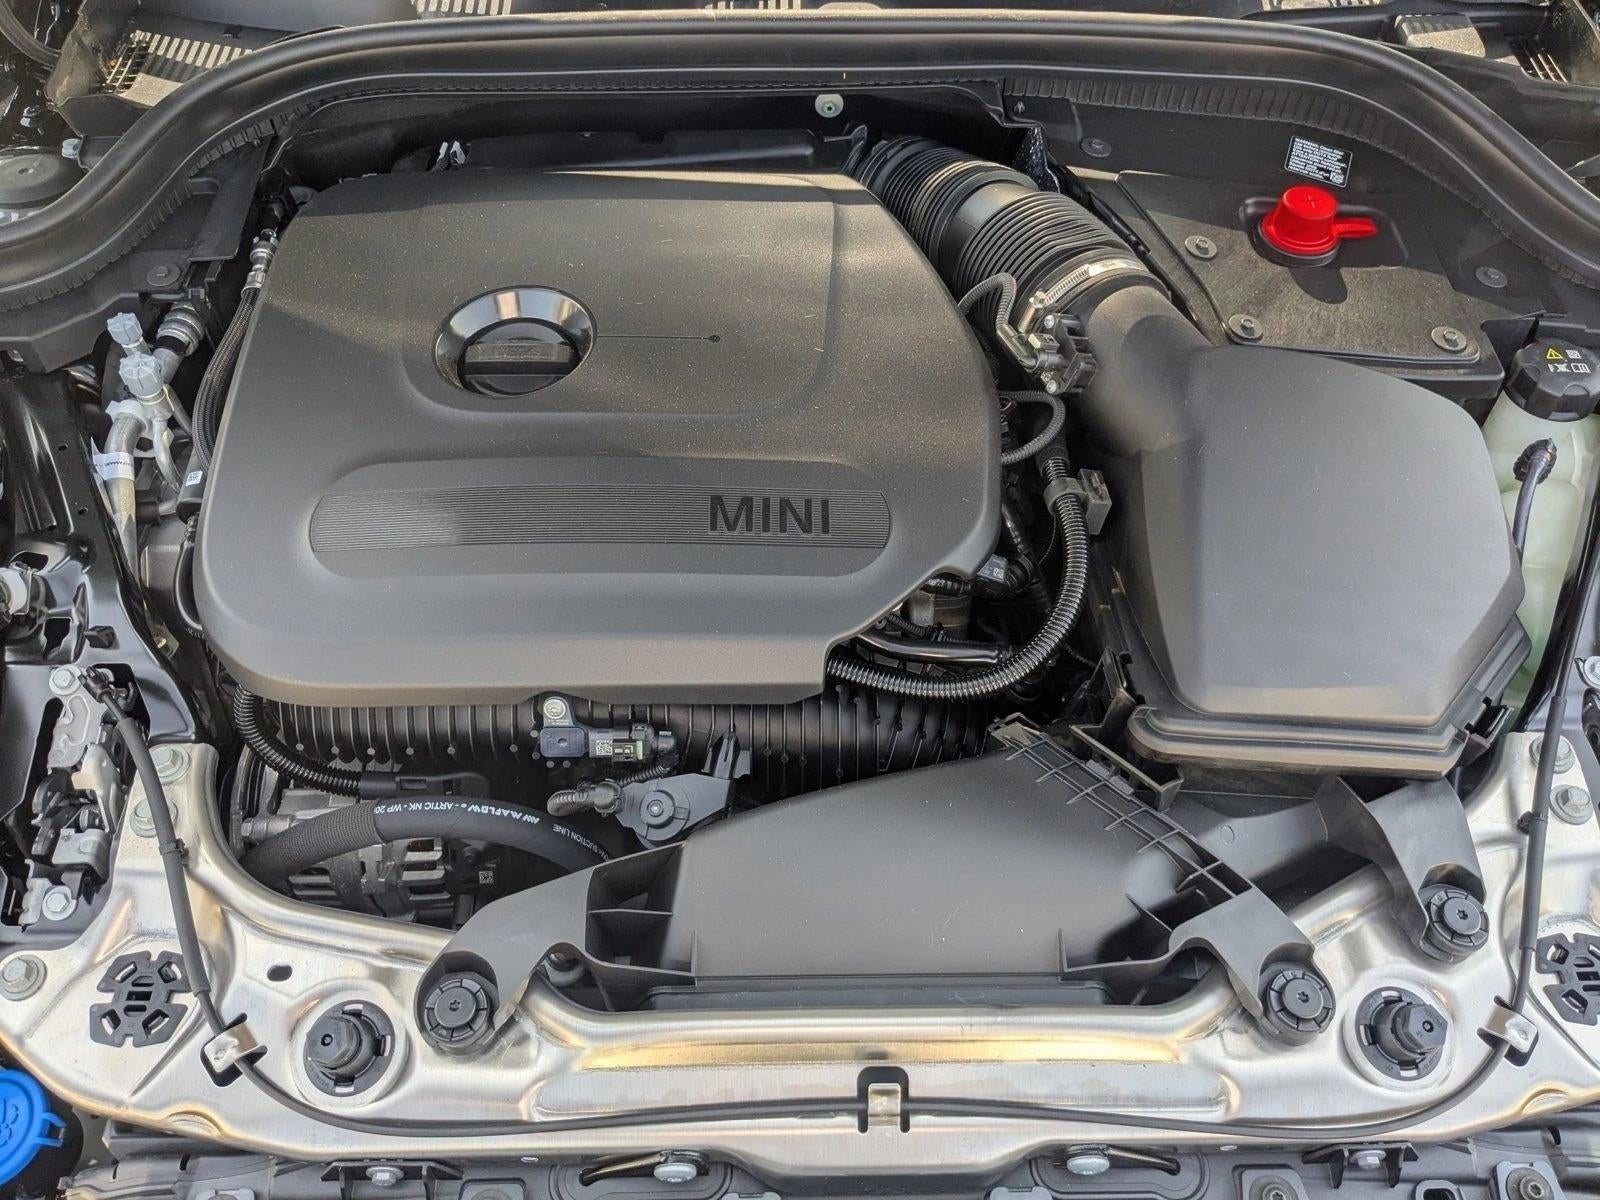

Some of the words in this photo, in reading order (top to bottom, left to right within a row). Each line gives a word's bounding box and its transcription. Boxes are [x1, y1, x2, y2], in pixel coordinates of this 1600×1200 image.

[709, 494, 830, 534] MINI
[386, 804, 402, 813] WP
[408, 802, 422, 812] NK
[424, 801, 454, 811] ARTIC
[467, 804, 523, 820] MAFLOW
[552, 823, 571, 837] LINE
[570, 831, 599, 854] SUCTION
